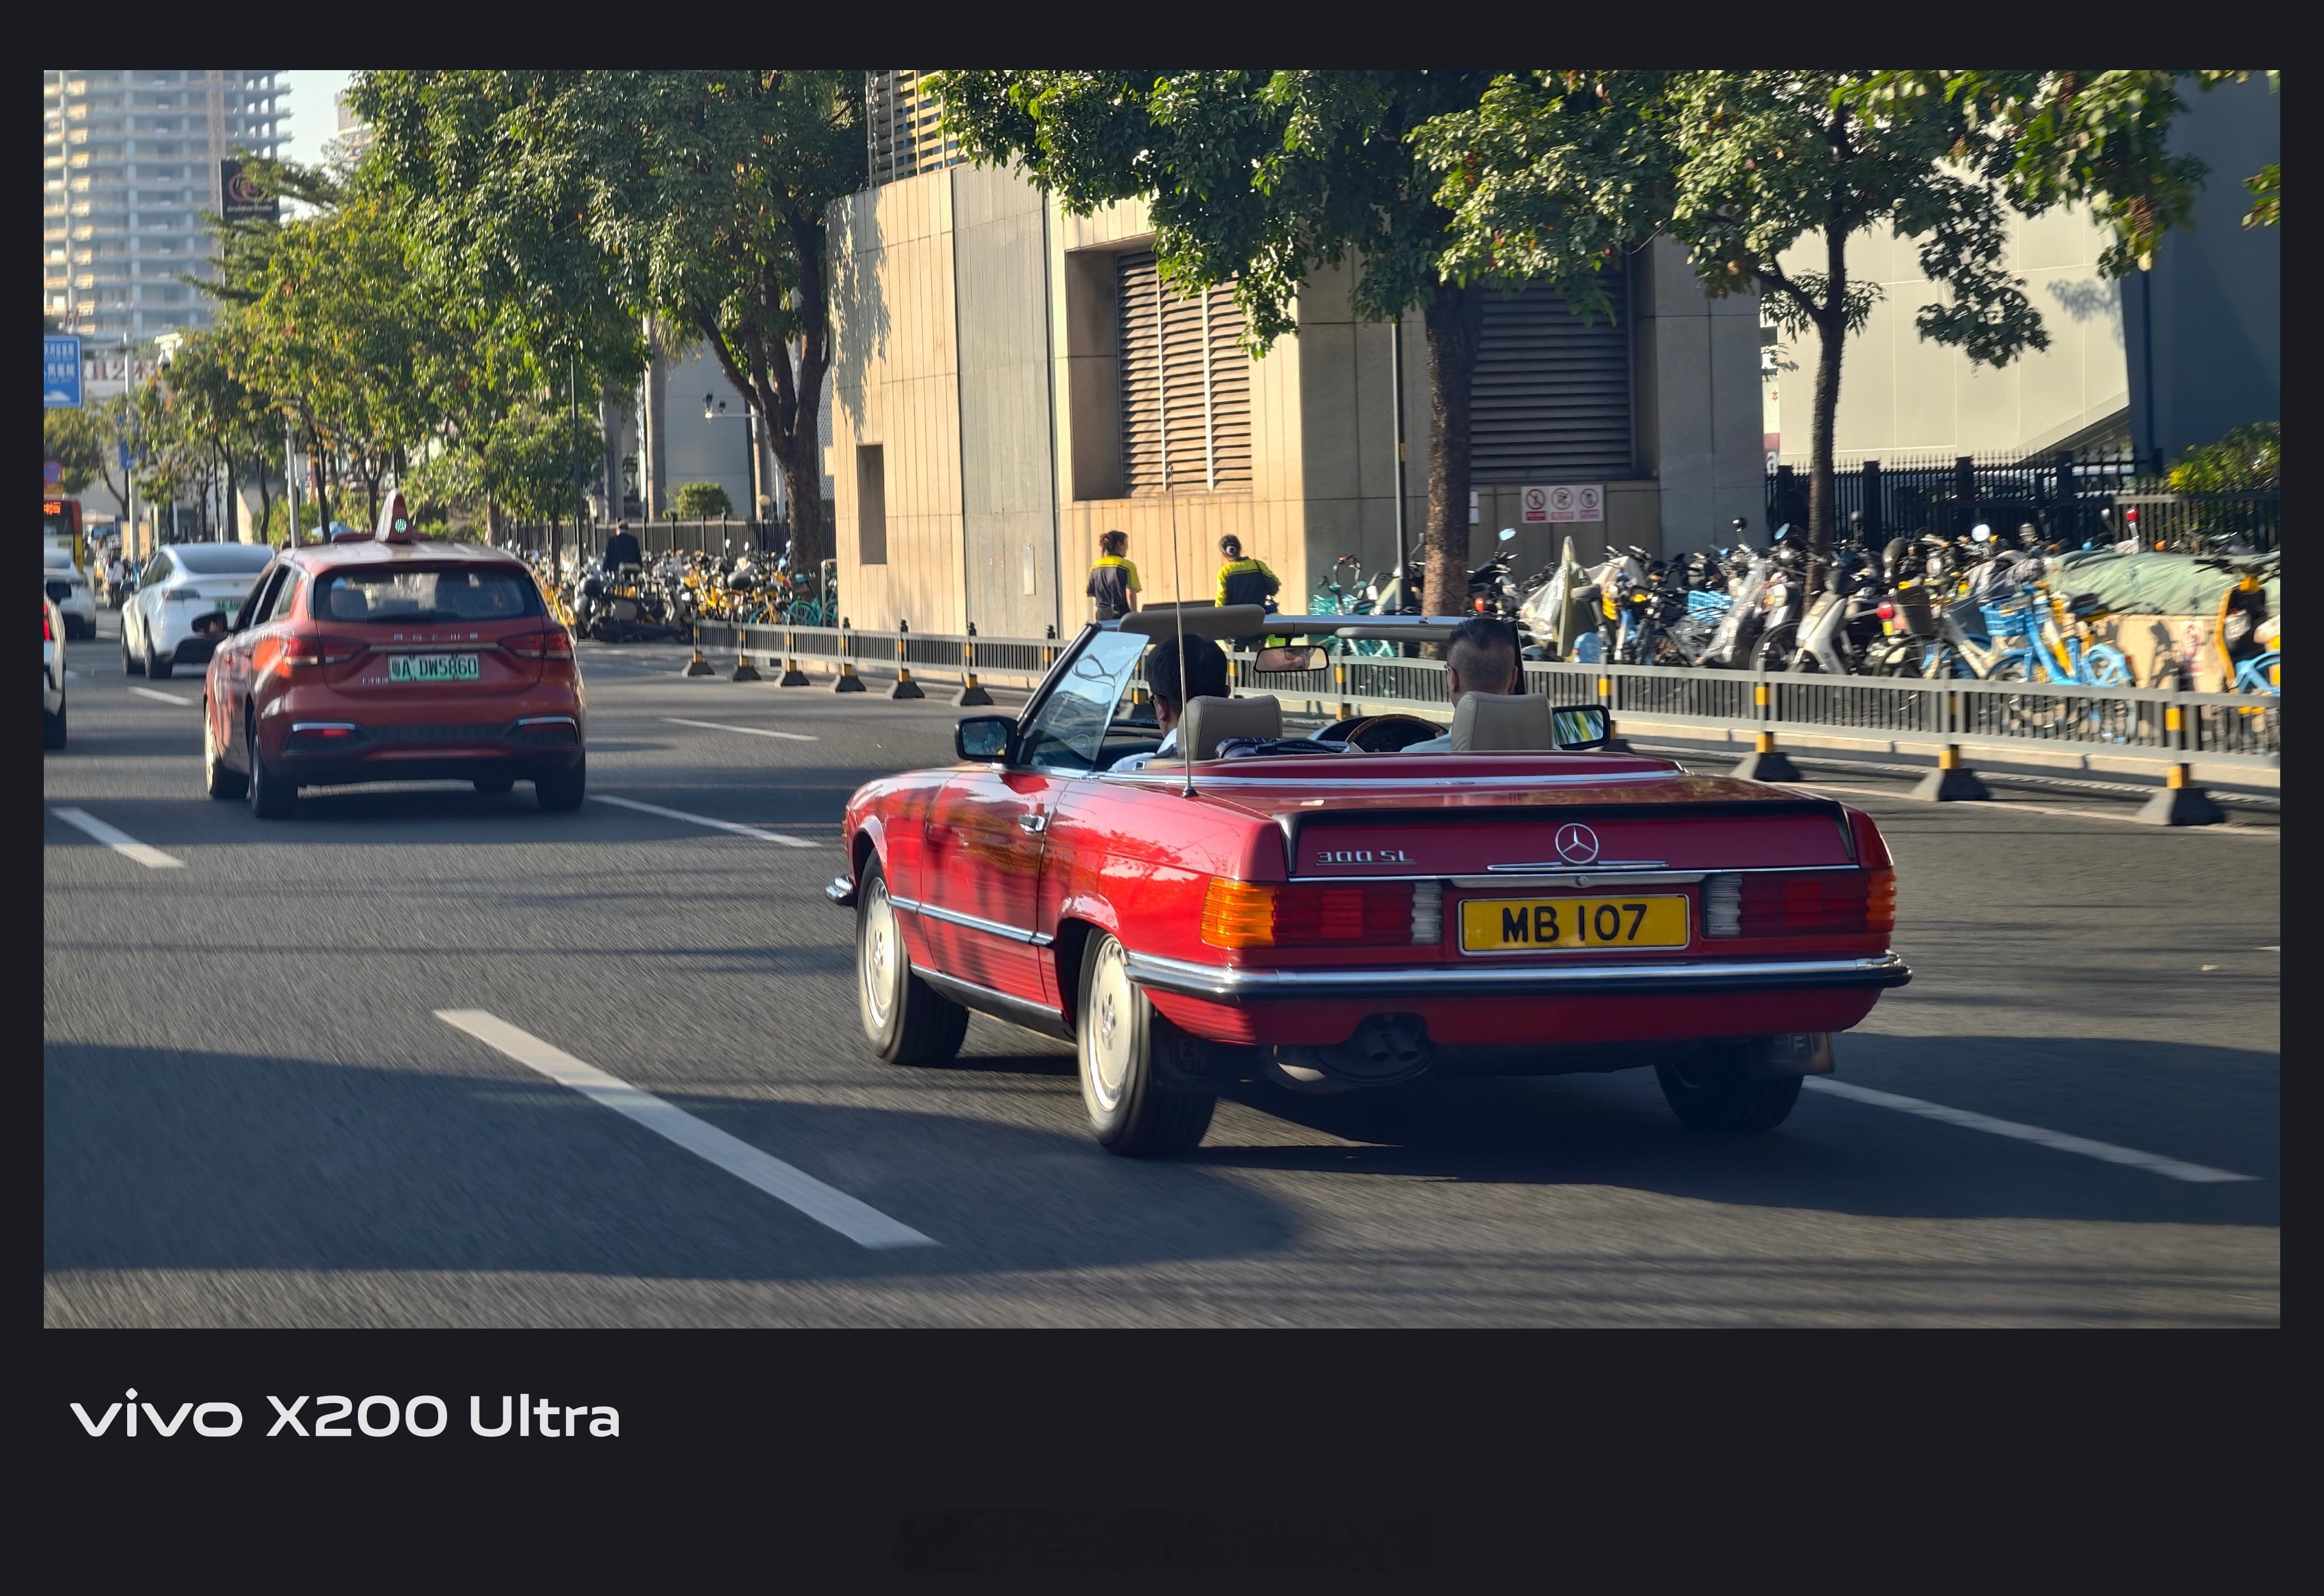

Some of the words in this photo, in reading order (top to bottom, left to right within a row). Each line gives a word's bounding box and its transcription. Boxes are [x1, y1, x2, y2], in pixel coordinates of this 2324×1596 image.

[1316, 851, 1373, 863] 300
[1380, 850, 1415, 862] SL
[1502, 906, 1560, 943] MB
[1577, 904, 1648, 941] 107
